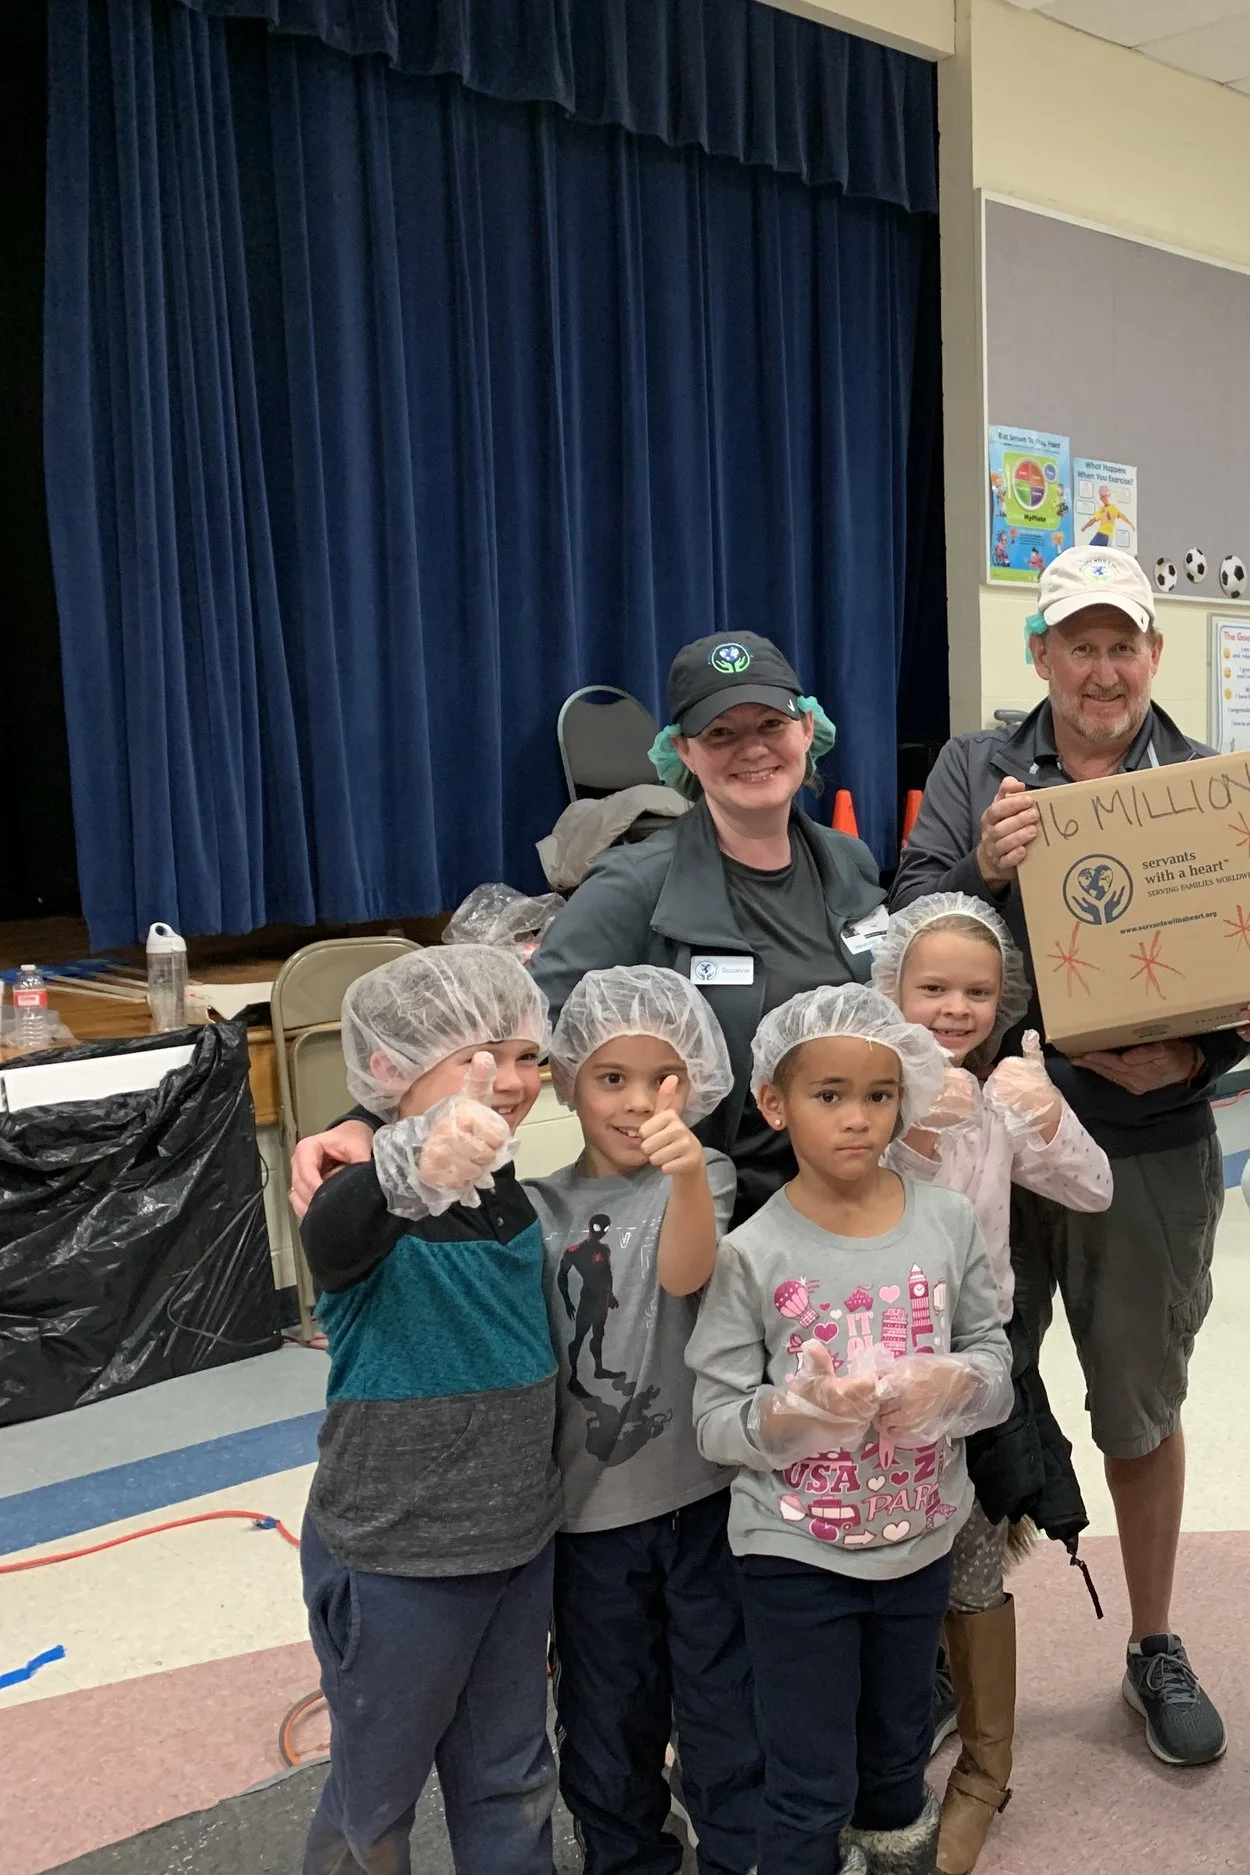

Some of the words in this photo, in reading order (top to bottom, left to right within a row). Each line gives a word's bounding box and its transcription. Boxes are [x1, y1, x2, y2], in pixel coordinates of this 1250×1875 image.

[1076, 470, 1095, 480] When
[1096, 473, 1108, 482] You
[1085, 461, 1101, 470] What
[1102, 463, 1127, 474] Happens
[1023, 514, 1046, 522] MyPlate
[1224, 631, 1236, 641] The
[1034, 800, 1079, 847] 16
[1142, 851, 1196, 870] servants
[1144, 869, 1175, 885] with
[1179, 870, 1187, 879] a
[1147, 885, 1179, 898] SERVING
[1181, 878, 1214, 892] FAMILIES
[1120, 911, 1217, 935] www.servantswithaheart.org
[783, 1463, 860, 1494] USA
